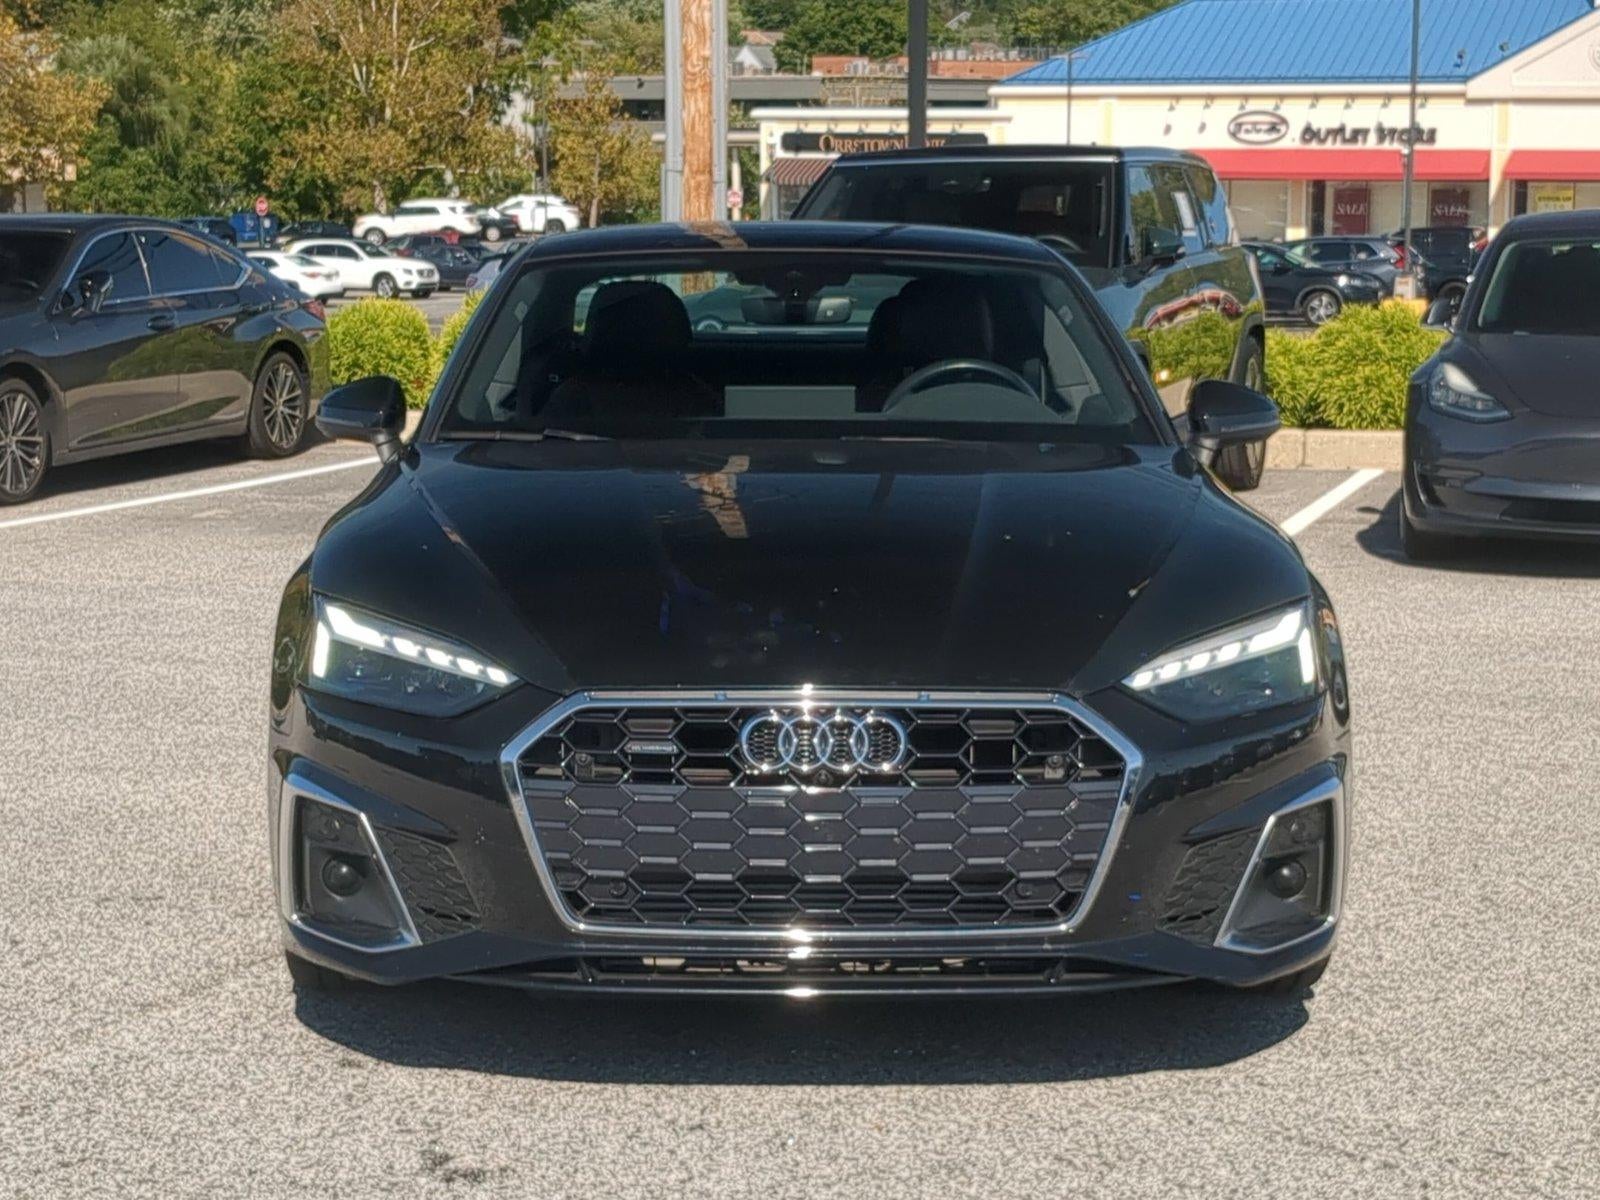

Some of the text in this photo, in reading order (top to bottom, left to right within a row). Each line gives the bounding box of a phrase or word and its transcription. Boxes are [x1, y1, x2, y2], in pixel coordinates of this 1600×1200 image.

[1300, 127, 1437, 145] OUTLET STORE
[1336, 203, 1367, 216] SALE
